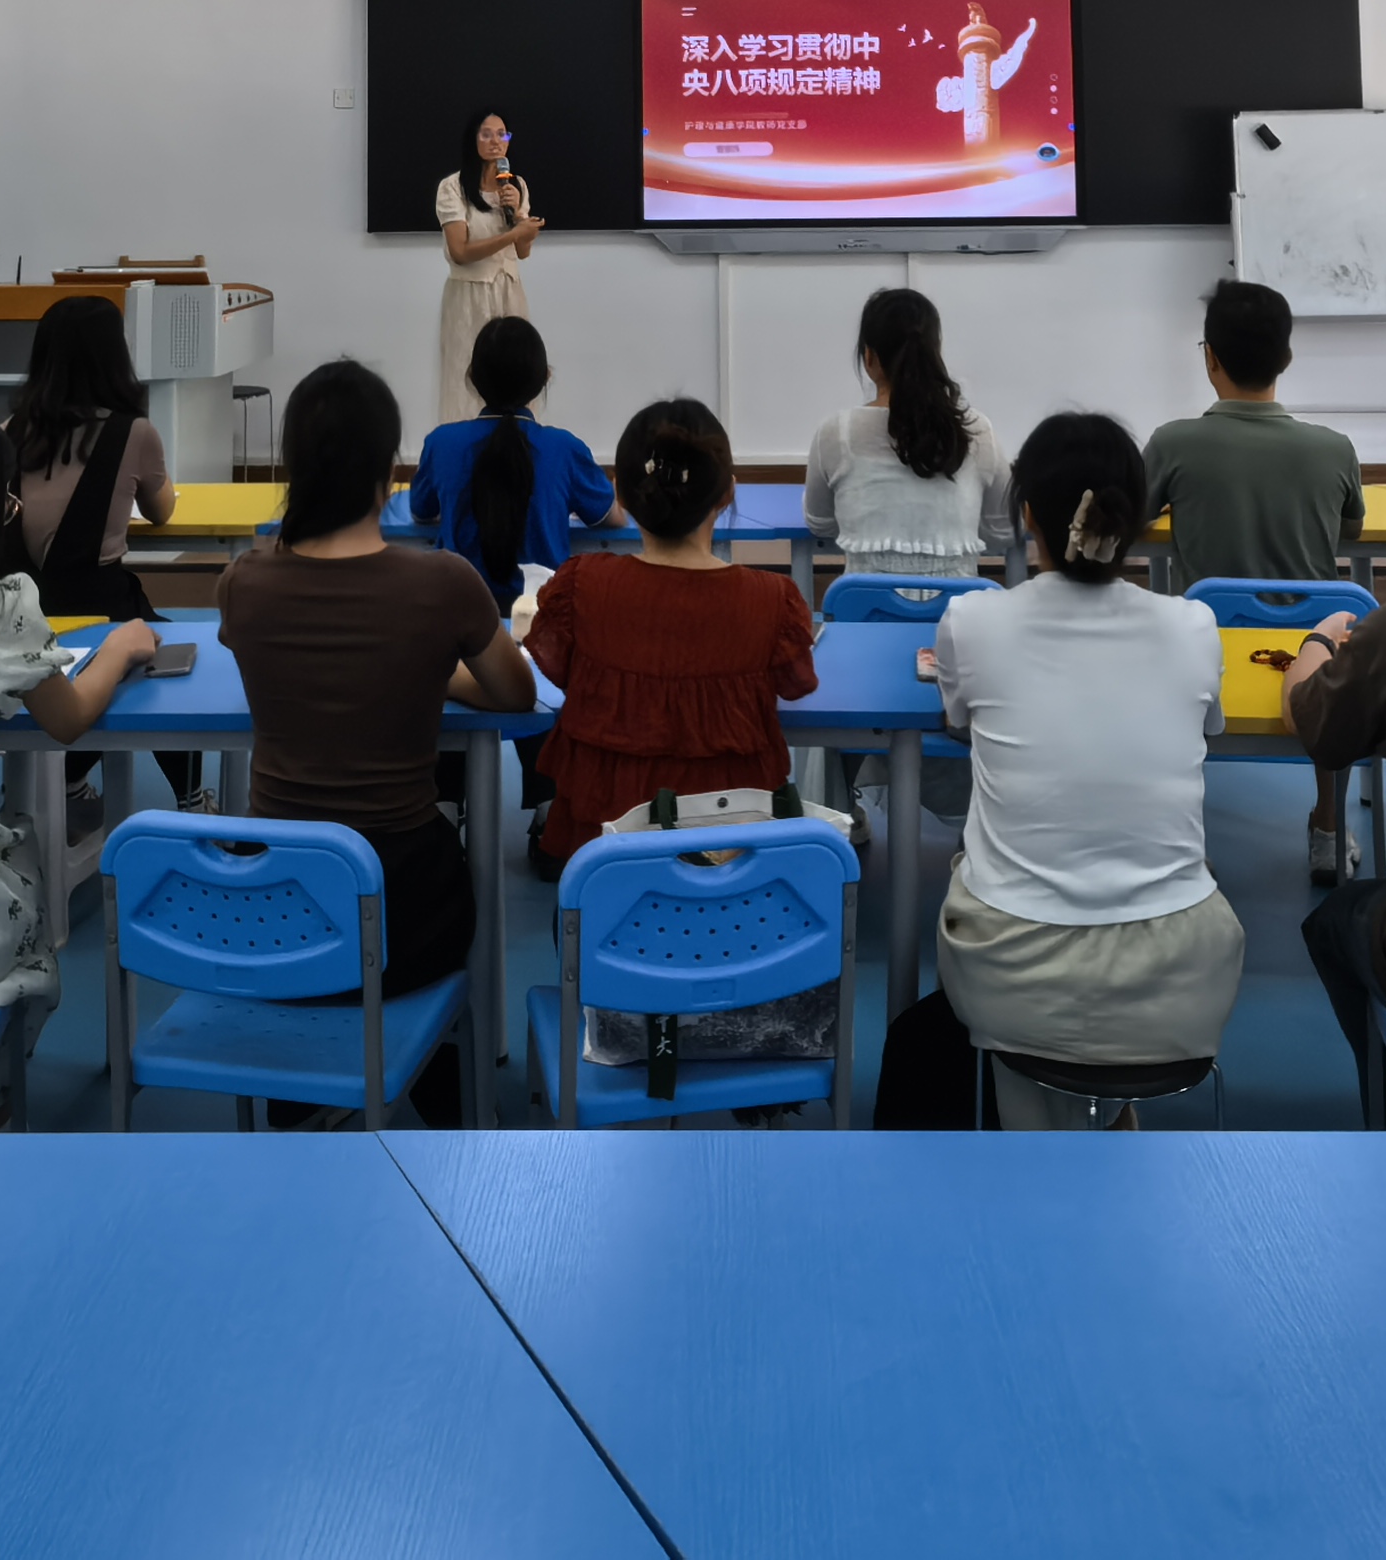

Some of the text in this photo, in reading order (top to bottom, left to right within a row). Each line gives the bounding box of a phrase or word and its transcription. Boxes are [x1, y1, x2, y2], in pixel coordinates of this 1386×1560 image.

[681, 32, 880, 62] 深入学习贯彻中
[682, 66, 881, 96] 央八项规定精神
